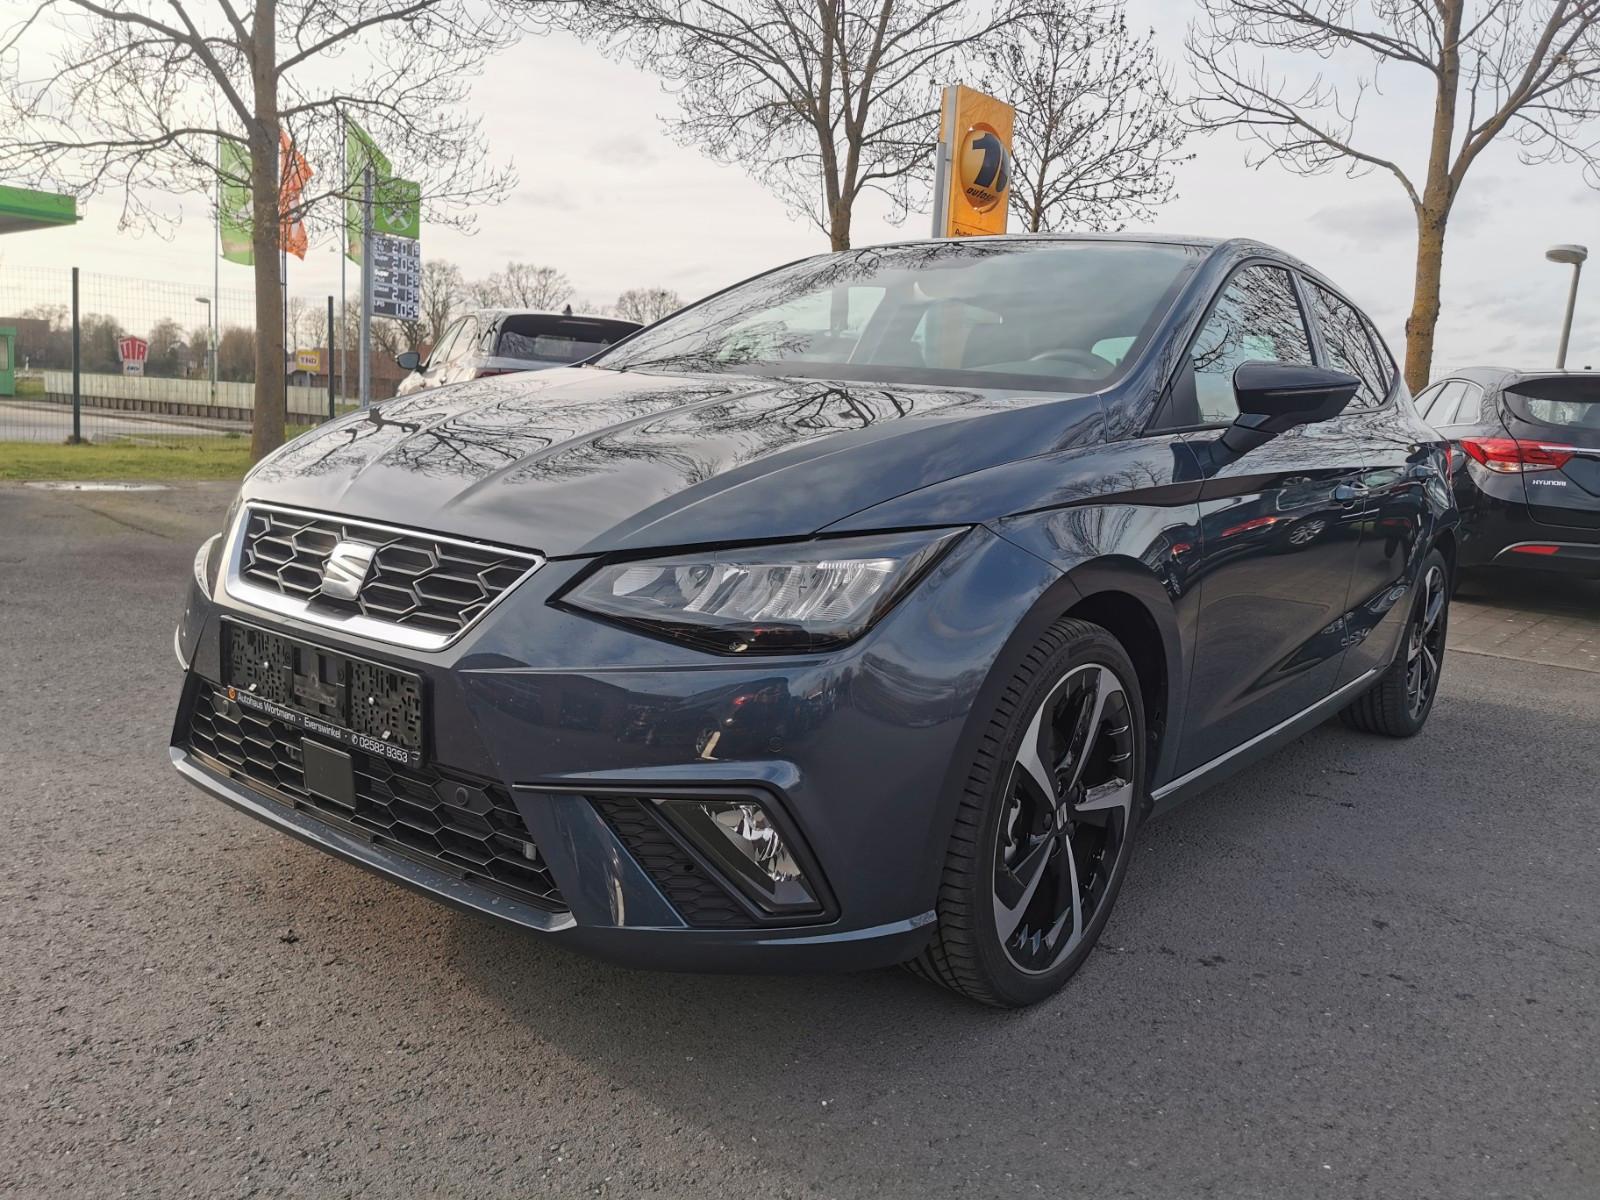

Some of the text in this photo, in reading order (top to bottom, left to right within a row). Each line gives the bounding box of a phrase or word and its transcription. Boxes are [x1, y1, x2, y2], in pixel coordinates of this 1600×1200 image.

[1532, 479, 1567, 487] HYUNDAI
[237, 691, 408, 763] Autohaus Wortmann Everswinkel 02582 9353
